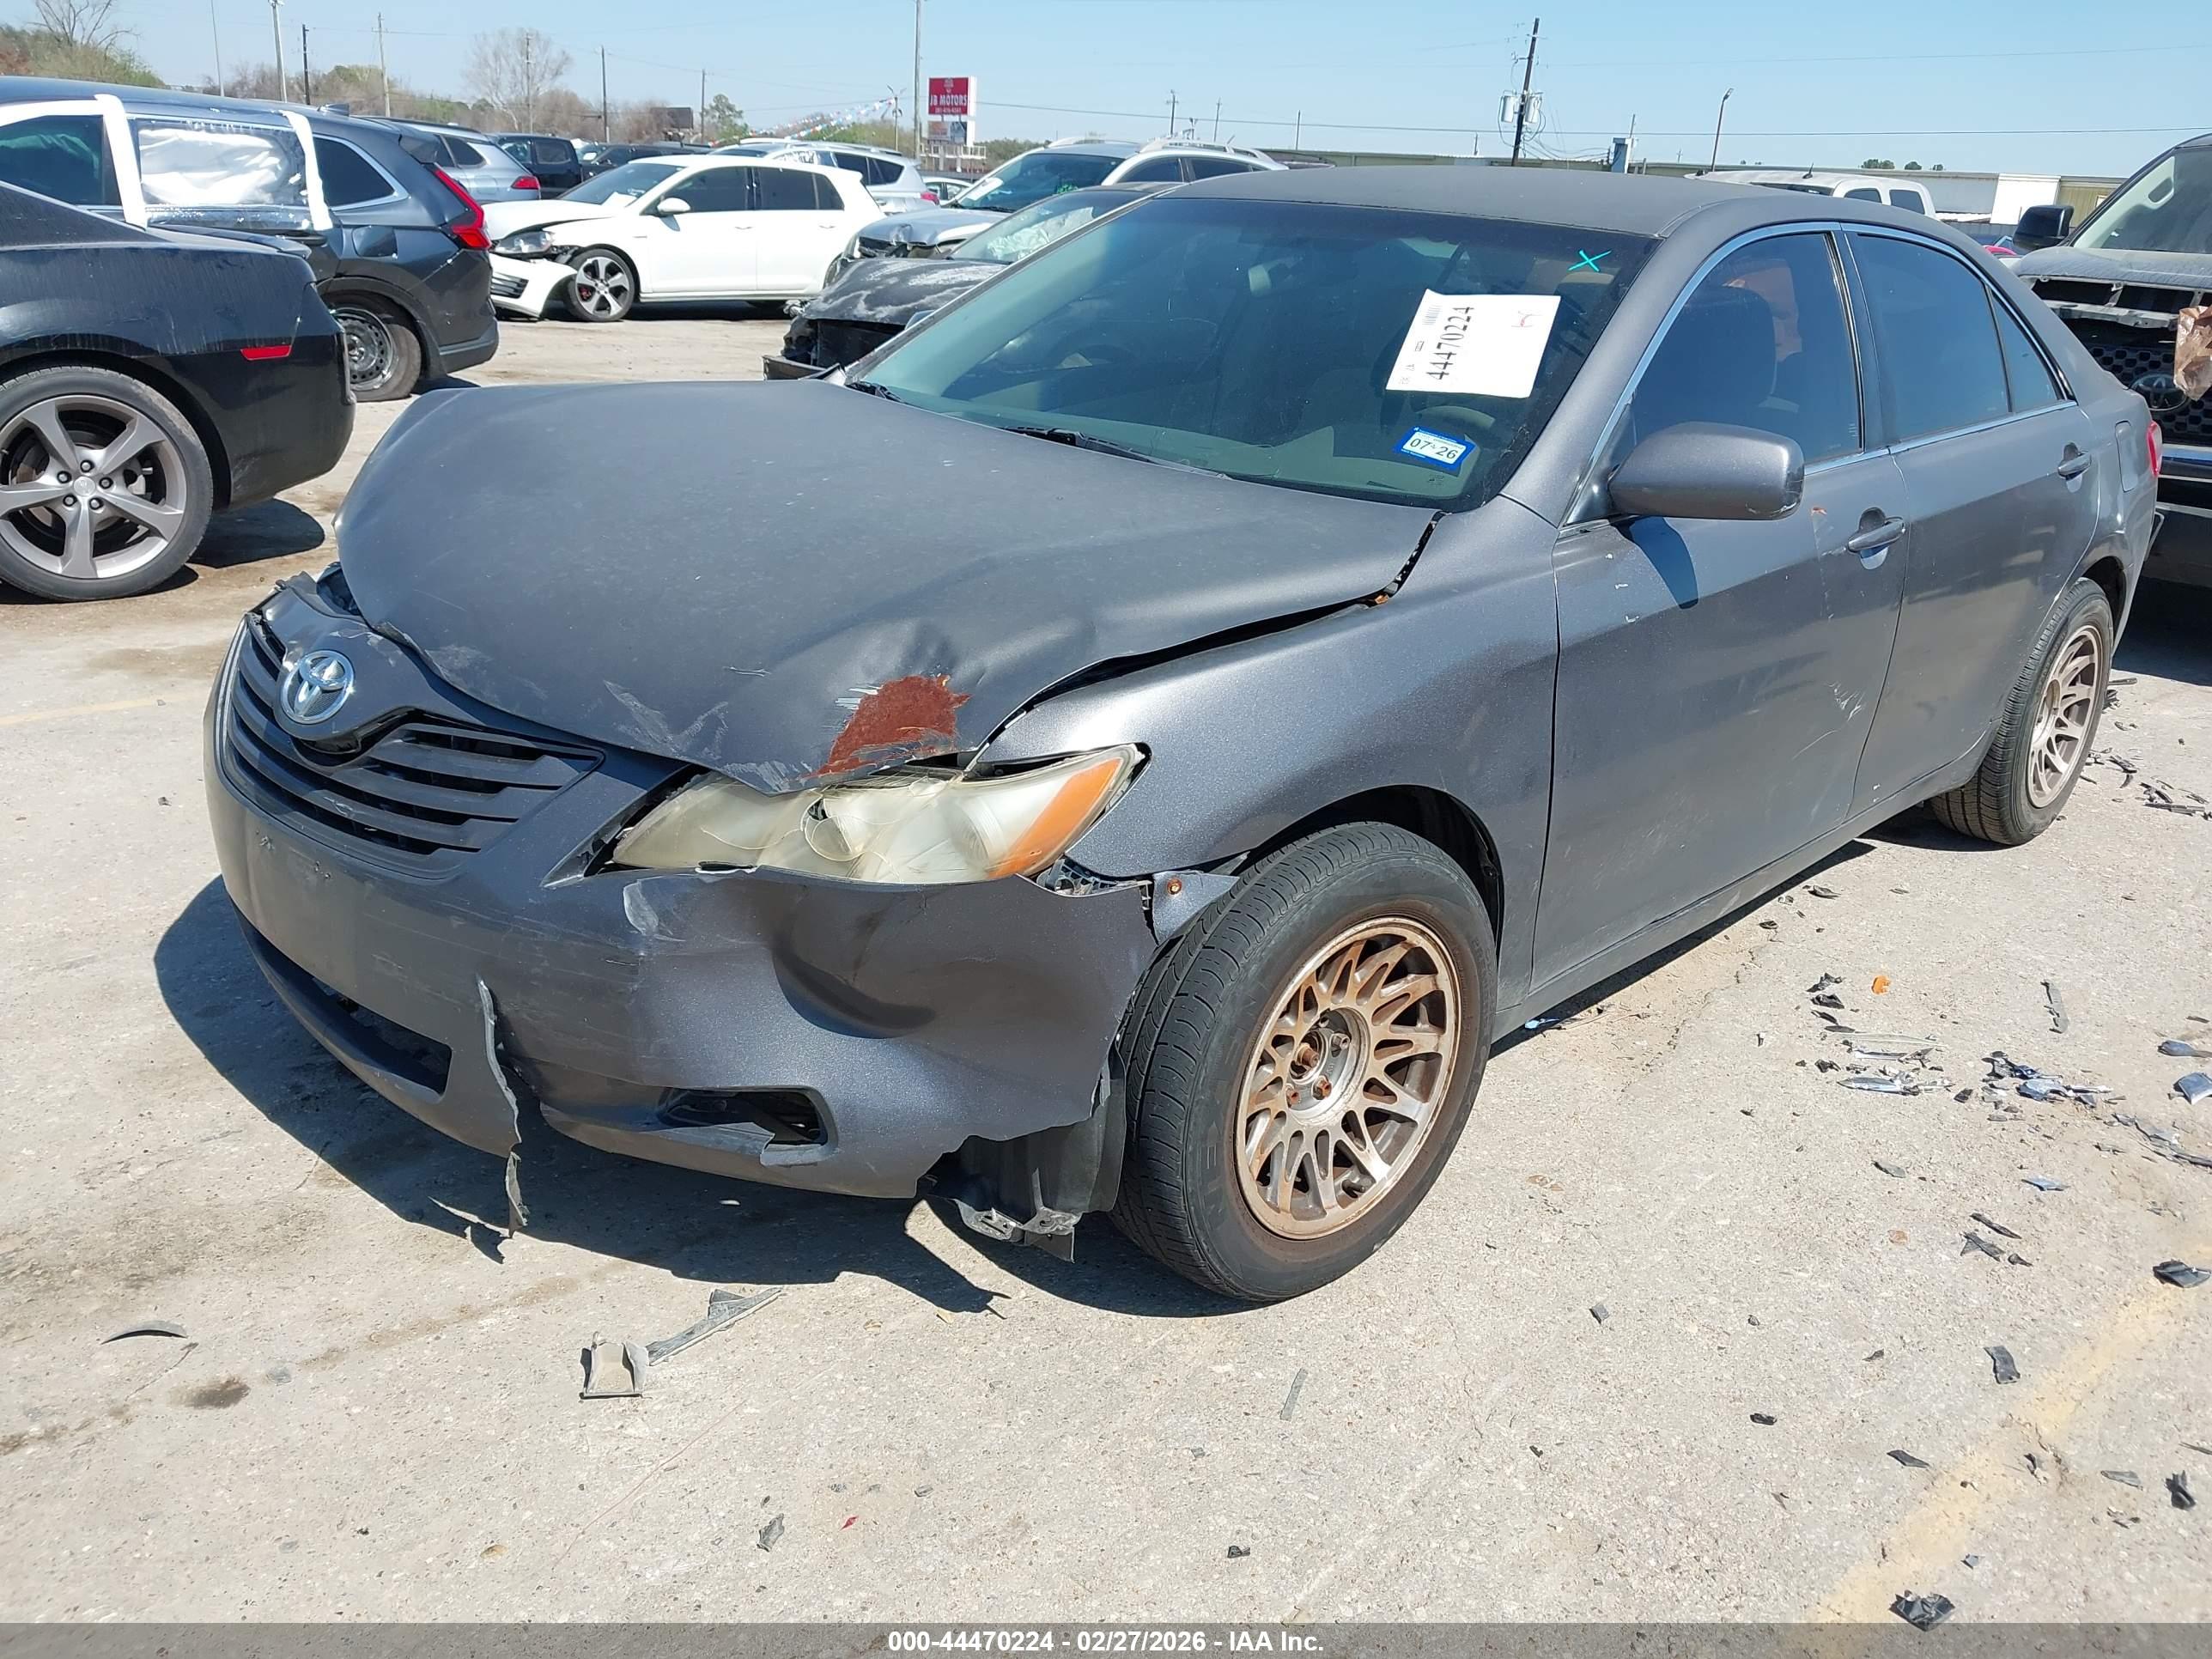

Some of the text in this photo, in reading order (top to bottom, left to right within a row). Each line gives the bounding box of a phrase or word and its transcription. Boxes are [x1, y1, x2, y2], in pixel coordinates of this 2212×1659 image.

[930, 94, 967, 106] JB MOTORS
[1425, 307, 1474, 380] 44470224
